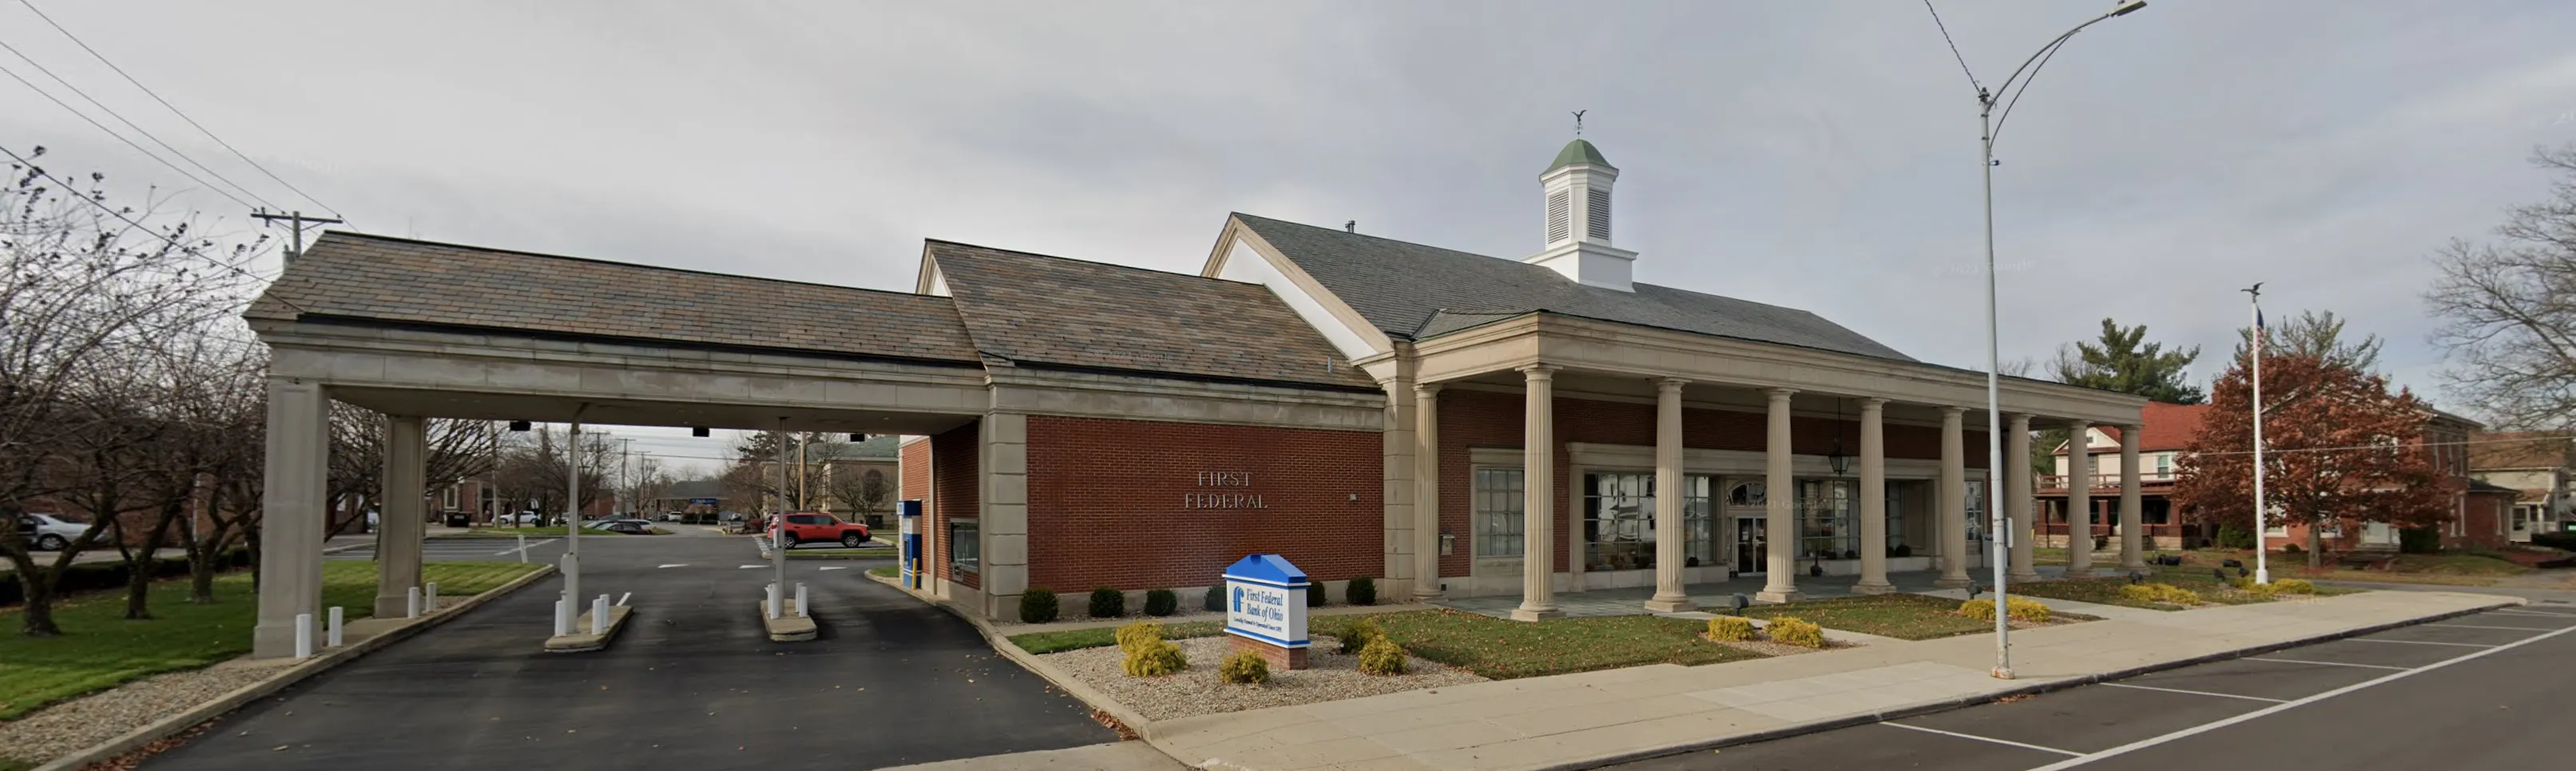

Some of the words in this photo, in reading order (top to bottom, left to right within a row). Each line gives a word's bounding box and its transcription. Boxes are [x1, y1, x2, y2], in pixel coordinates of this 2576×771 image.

[1198, 471, 1252, 487] FIRST
[1185, 493, 1268, 509] FEDERAL
[1246, 588, 1260, 602] First
[1261, 590, 1283, 606] Federal
[1247, 602, 1261, 617] Bank
[1262, 606, 1268, 622] of
[1268, 607, 1284, 622] Ohio
